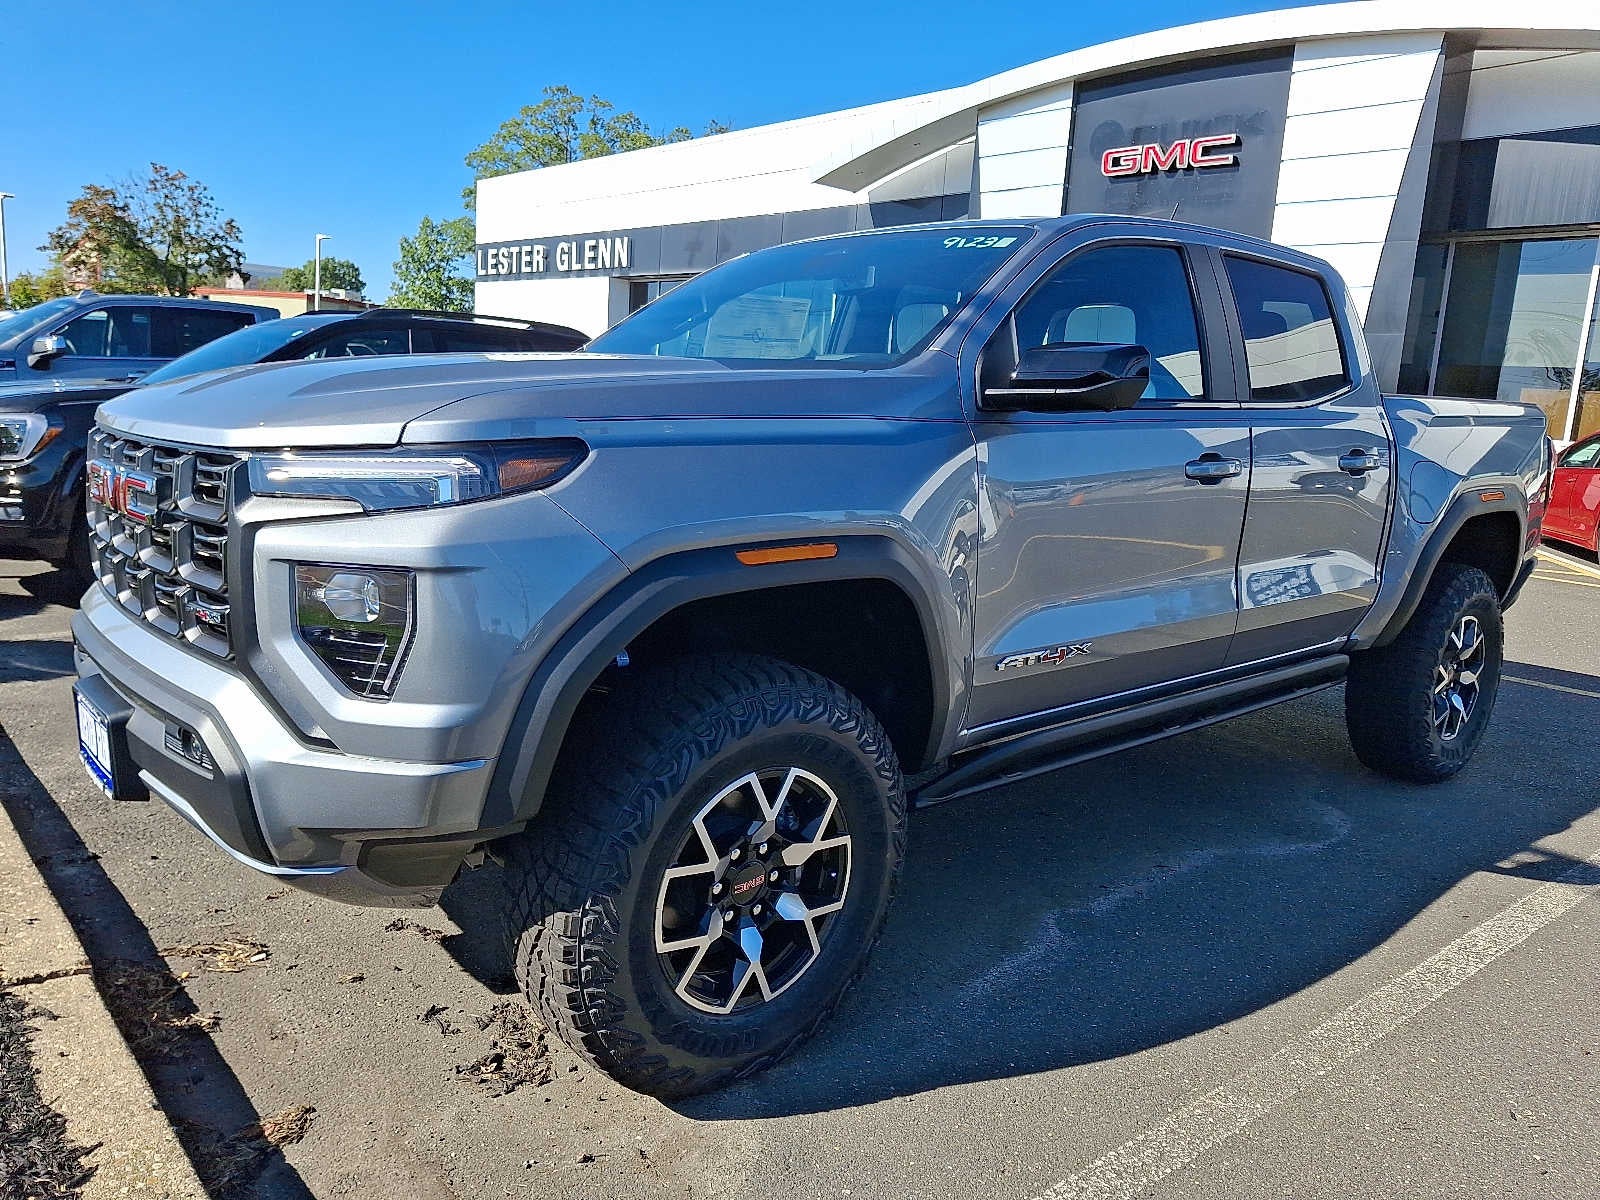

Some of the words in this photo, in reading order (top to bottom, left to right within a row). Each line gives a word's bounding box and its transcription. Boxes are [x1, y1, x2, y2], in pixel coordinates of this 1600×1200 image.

[1101, 133, 1237, 177] GMC
[477, 245, 545, 276] LESTER
[556, 236, 629, 272] GLENN
[87, 458, 157, 524] GMC
[995, 642, 1093, 671] AT4X
